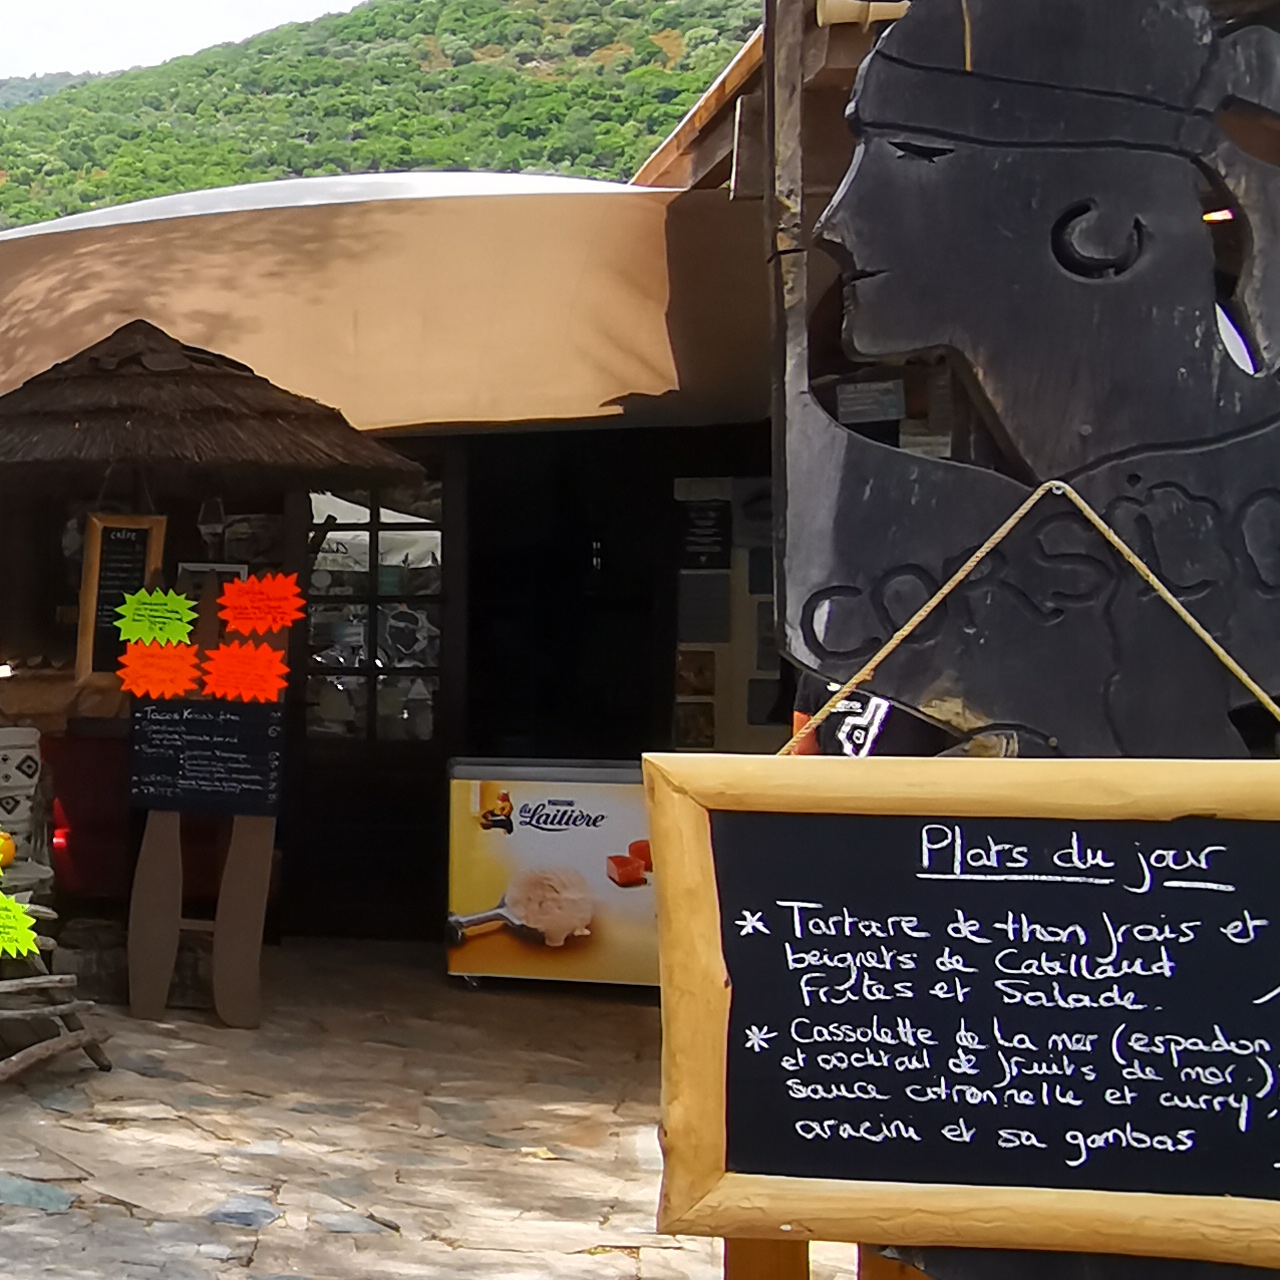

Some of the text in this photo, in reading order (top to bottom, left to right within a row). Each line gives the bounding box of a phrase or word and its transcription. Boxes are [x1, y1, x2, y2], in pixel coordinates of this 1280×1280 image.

[920, 823, 1228, 894] Plats du jour
[775, 900, 1269, 965] Tartare de thon frais et
[784, 942, 918, 992] beignets
[935, 946, 979, 974] de
[929, 977, 972, 1003] et
[790, 1014, 939, 1047] Cassolette
[955, 1018, 989, 1050] de
[780, 1047, 807, 1071] et
[947, 1047, 980, 1075] de
[1121, 1059, 1164, 1082] de
[1104, 1085, 1138, 1107] et
[1158, 1092, 1250, 1133] curry
[940, 1117, 977, 1144] et
[997, 1128, 1048, 1150] sa
[1064, 1122, 1196, 1168] gambas
